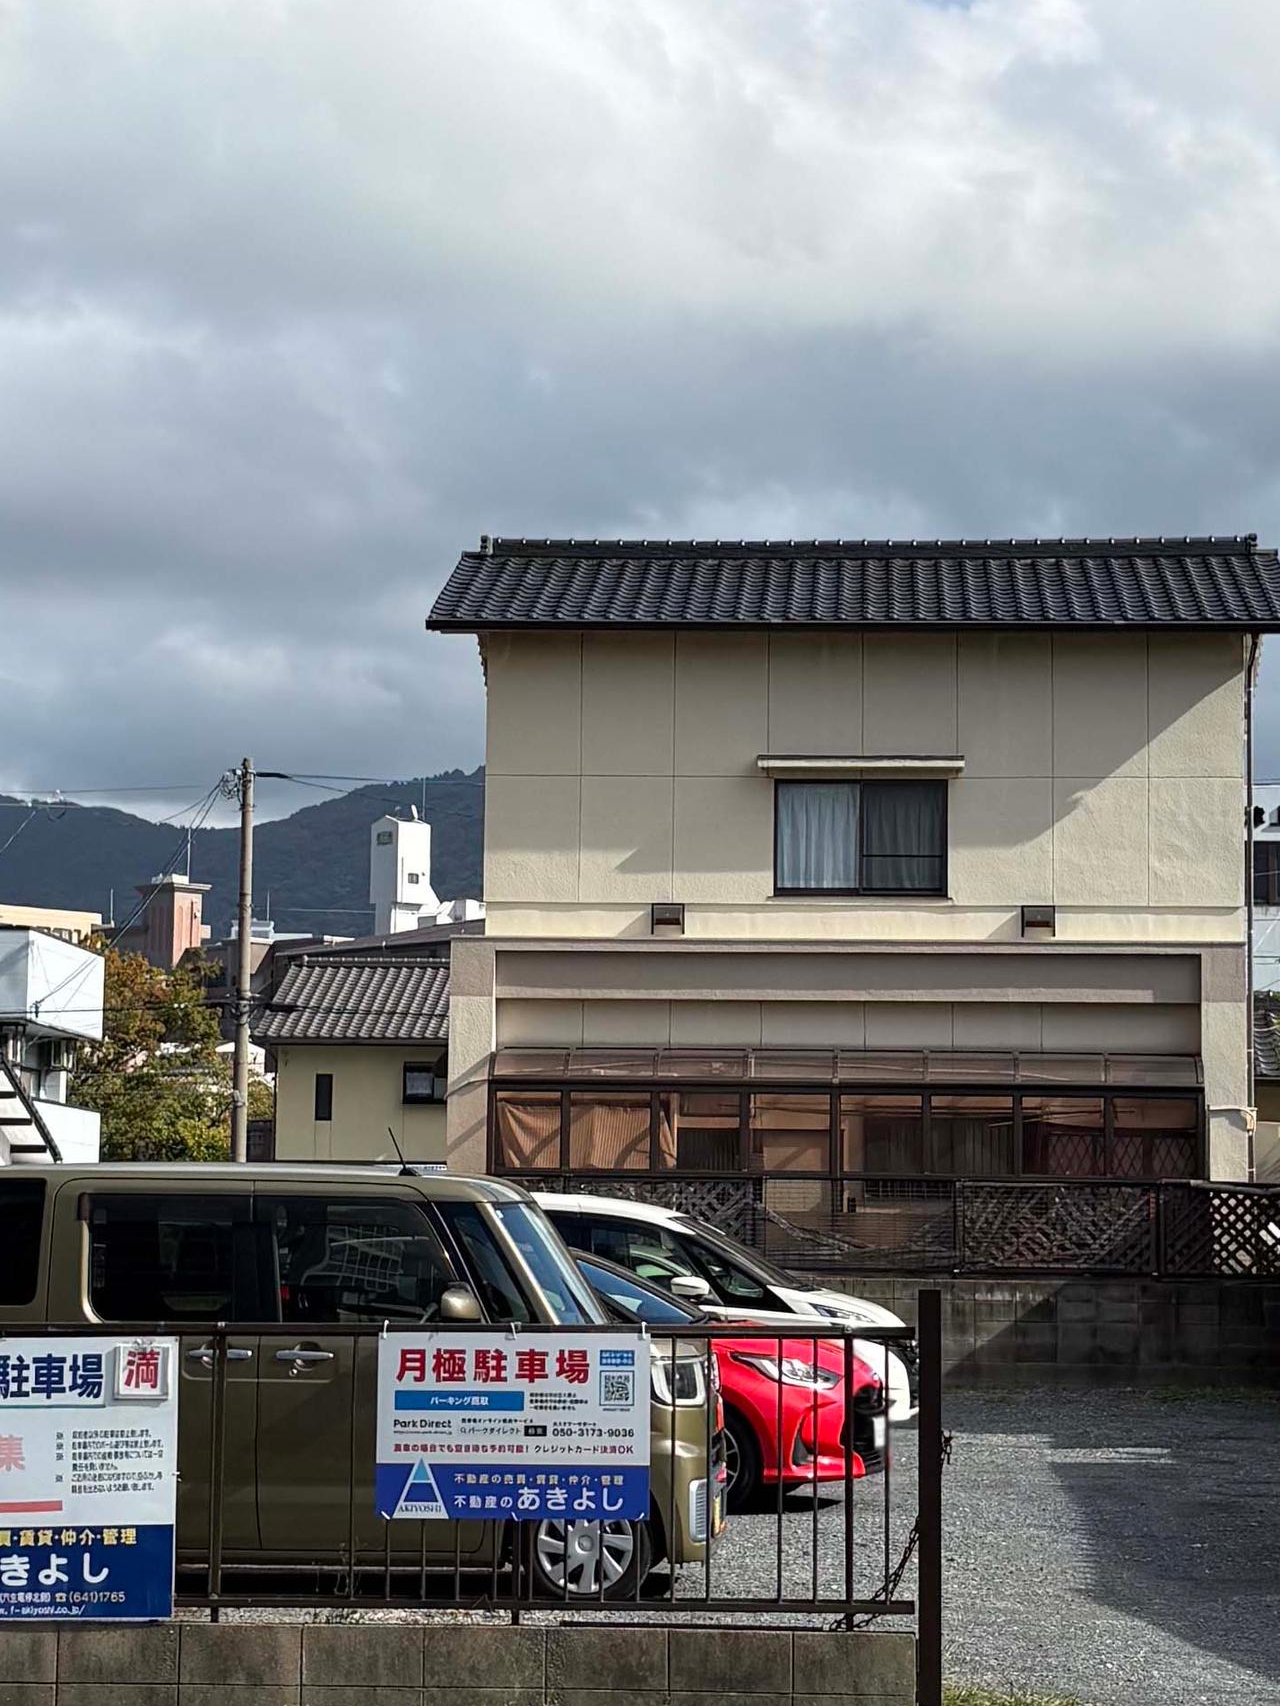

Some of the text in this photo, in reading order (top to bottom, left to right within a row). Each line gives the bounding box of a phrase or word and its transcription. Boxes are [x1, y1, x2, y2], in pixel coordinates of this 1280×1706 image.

[123, 1350, 161, 1390] 満
[396, 1348, 591, 1384] 月極駐車場
[393, 1419, 452, 1428] Park Direct
[468, 1427, 521, 1435] パークダイレクト
[552, 1428, 634, 1438] 050-3173-9036
[453, 1487, 624, 1511] 不動産のあきよし
[397, 1503, 442, 1513] AKIYOSHI
[68, 1590, 126, 1604] (641)1765
